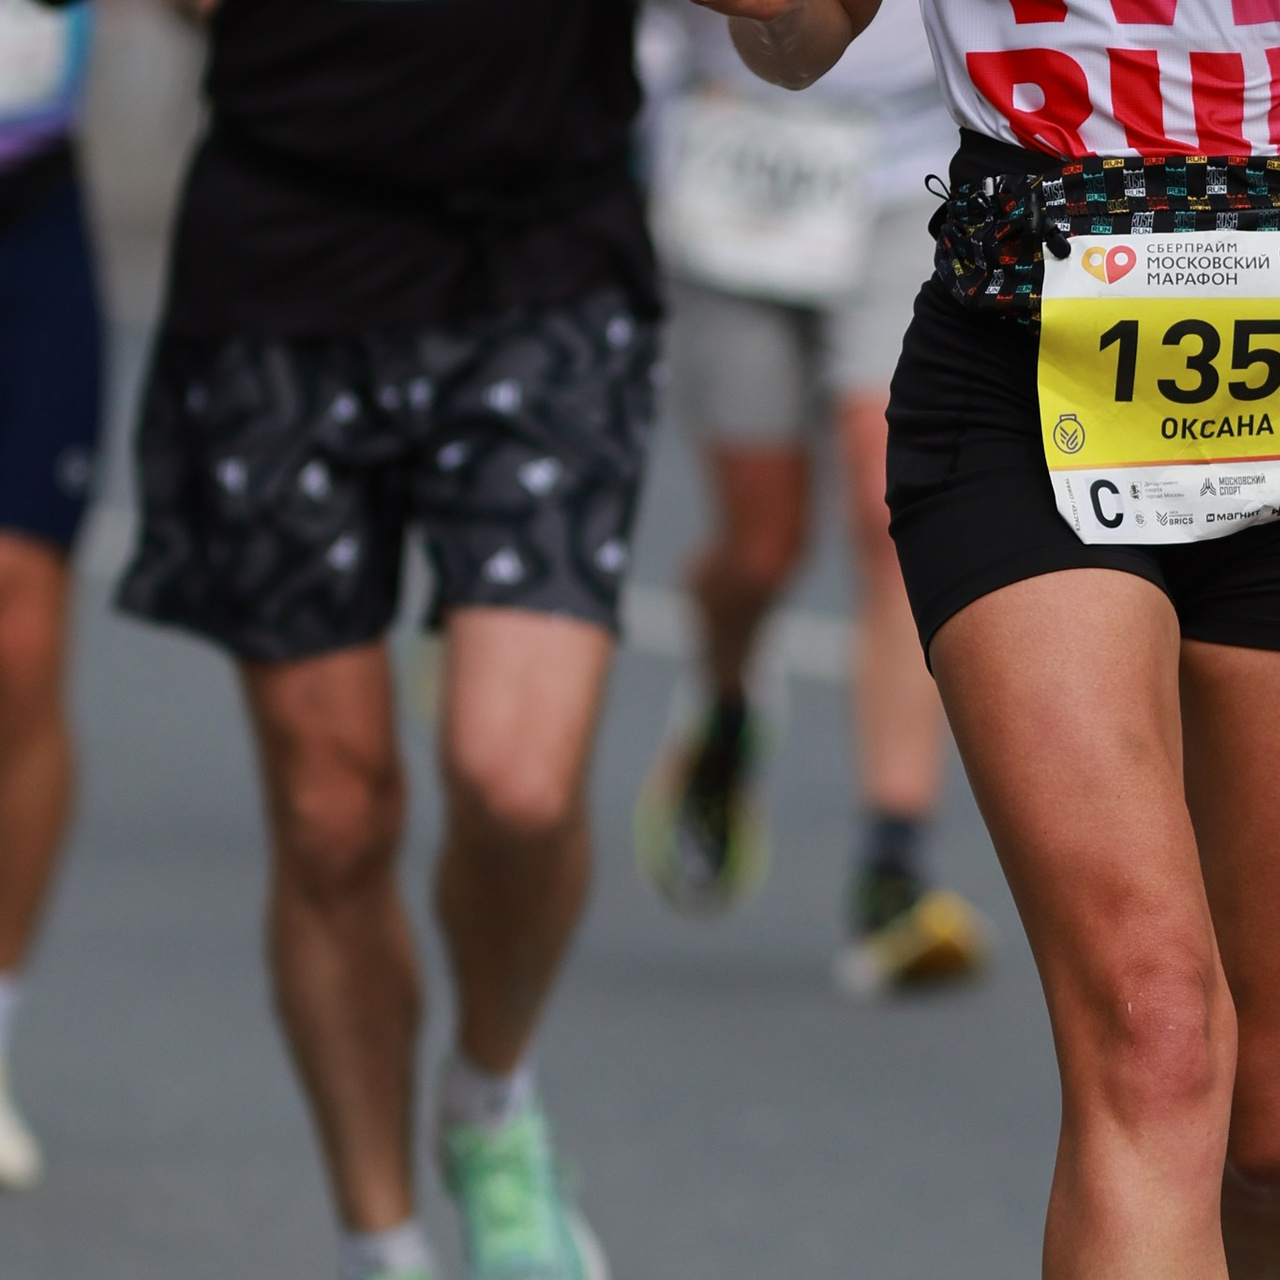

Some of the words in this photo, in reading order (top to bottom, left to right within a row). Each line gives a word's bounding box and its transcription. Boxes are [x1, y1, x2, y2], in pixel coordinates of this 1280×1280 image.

[1206, 170, 1227, 185] ROSA
[1132, 214, 1154, 227] ROSA
[1216, 213, 1238, 228] ROSA
[1146, 241, 1238, 253] СБЕРПРАЙМ
[1146, 253, 1270, 269] МОСКОВСКИЙ
[1146, 272, 1238, 286] МАРАФОН
[1161, 412, 1275, 439] ОКСАНА
[1218, 473, 1266, 486] МОСКОВСКИЙ
[1219, 486, 1241, 496] СПОРТ
[1169, 517, 1193, 526] BRICS
